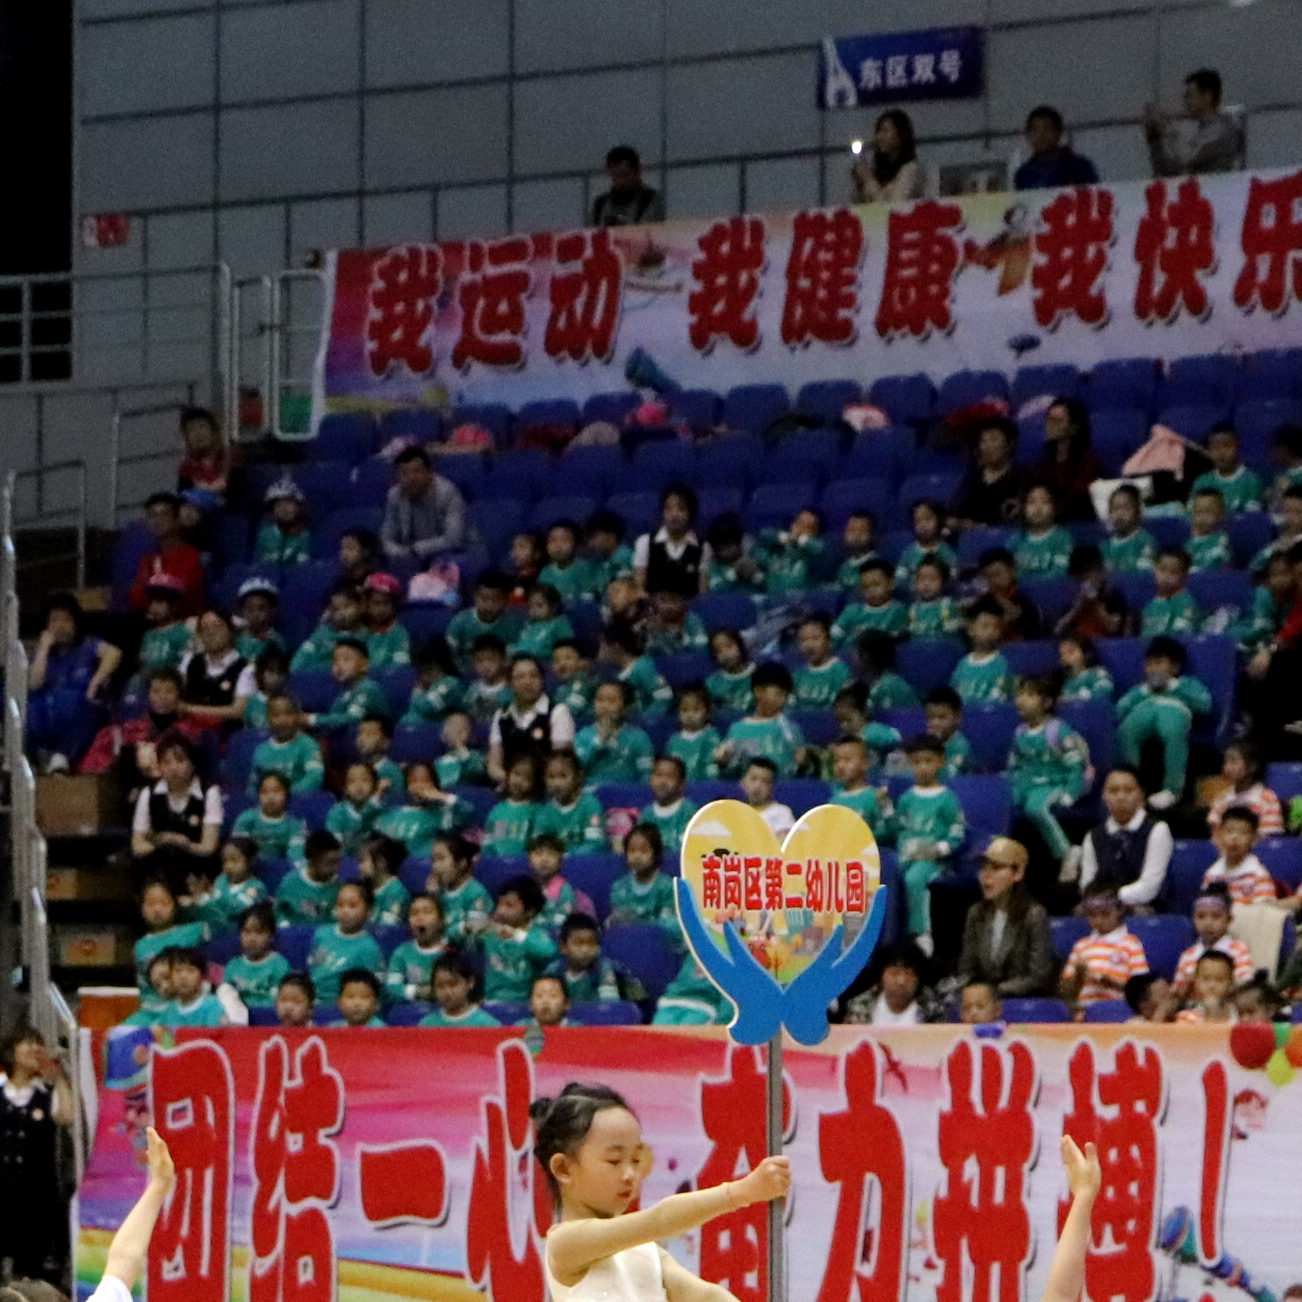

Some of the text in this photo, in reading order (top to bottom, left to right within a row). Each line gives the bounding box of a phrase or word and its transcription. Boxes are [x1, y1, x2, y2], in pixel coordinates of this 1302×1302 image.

[859, 49, 961, 89] 东区双号
[366, 229, 625, 378] 我运动
[687, 202, 965, 352] 我健康
[702, 855, 866, 914] 南岗区第二幼儿园
